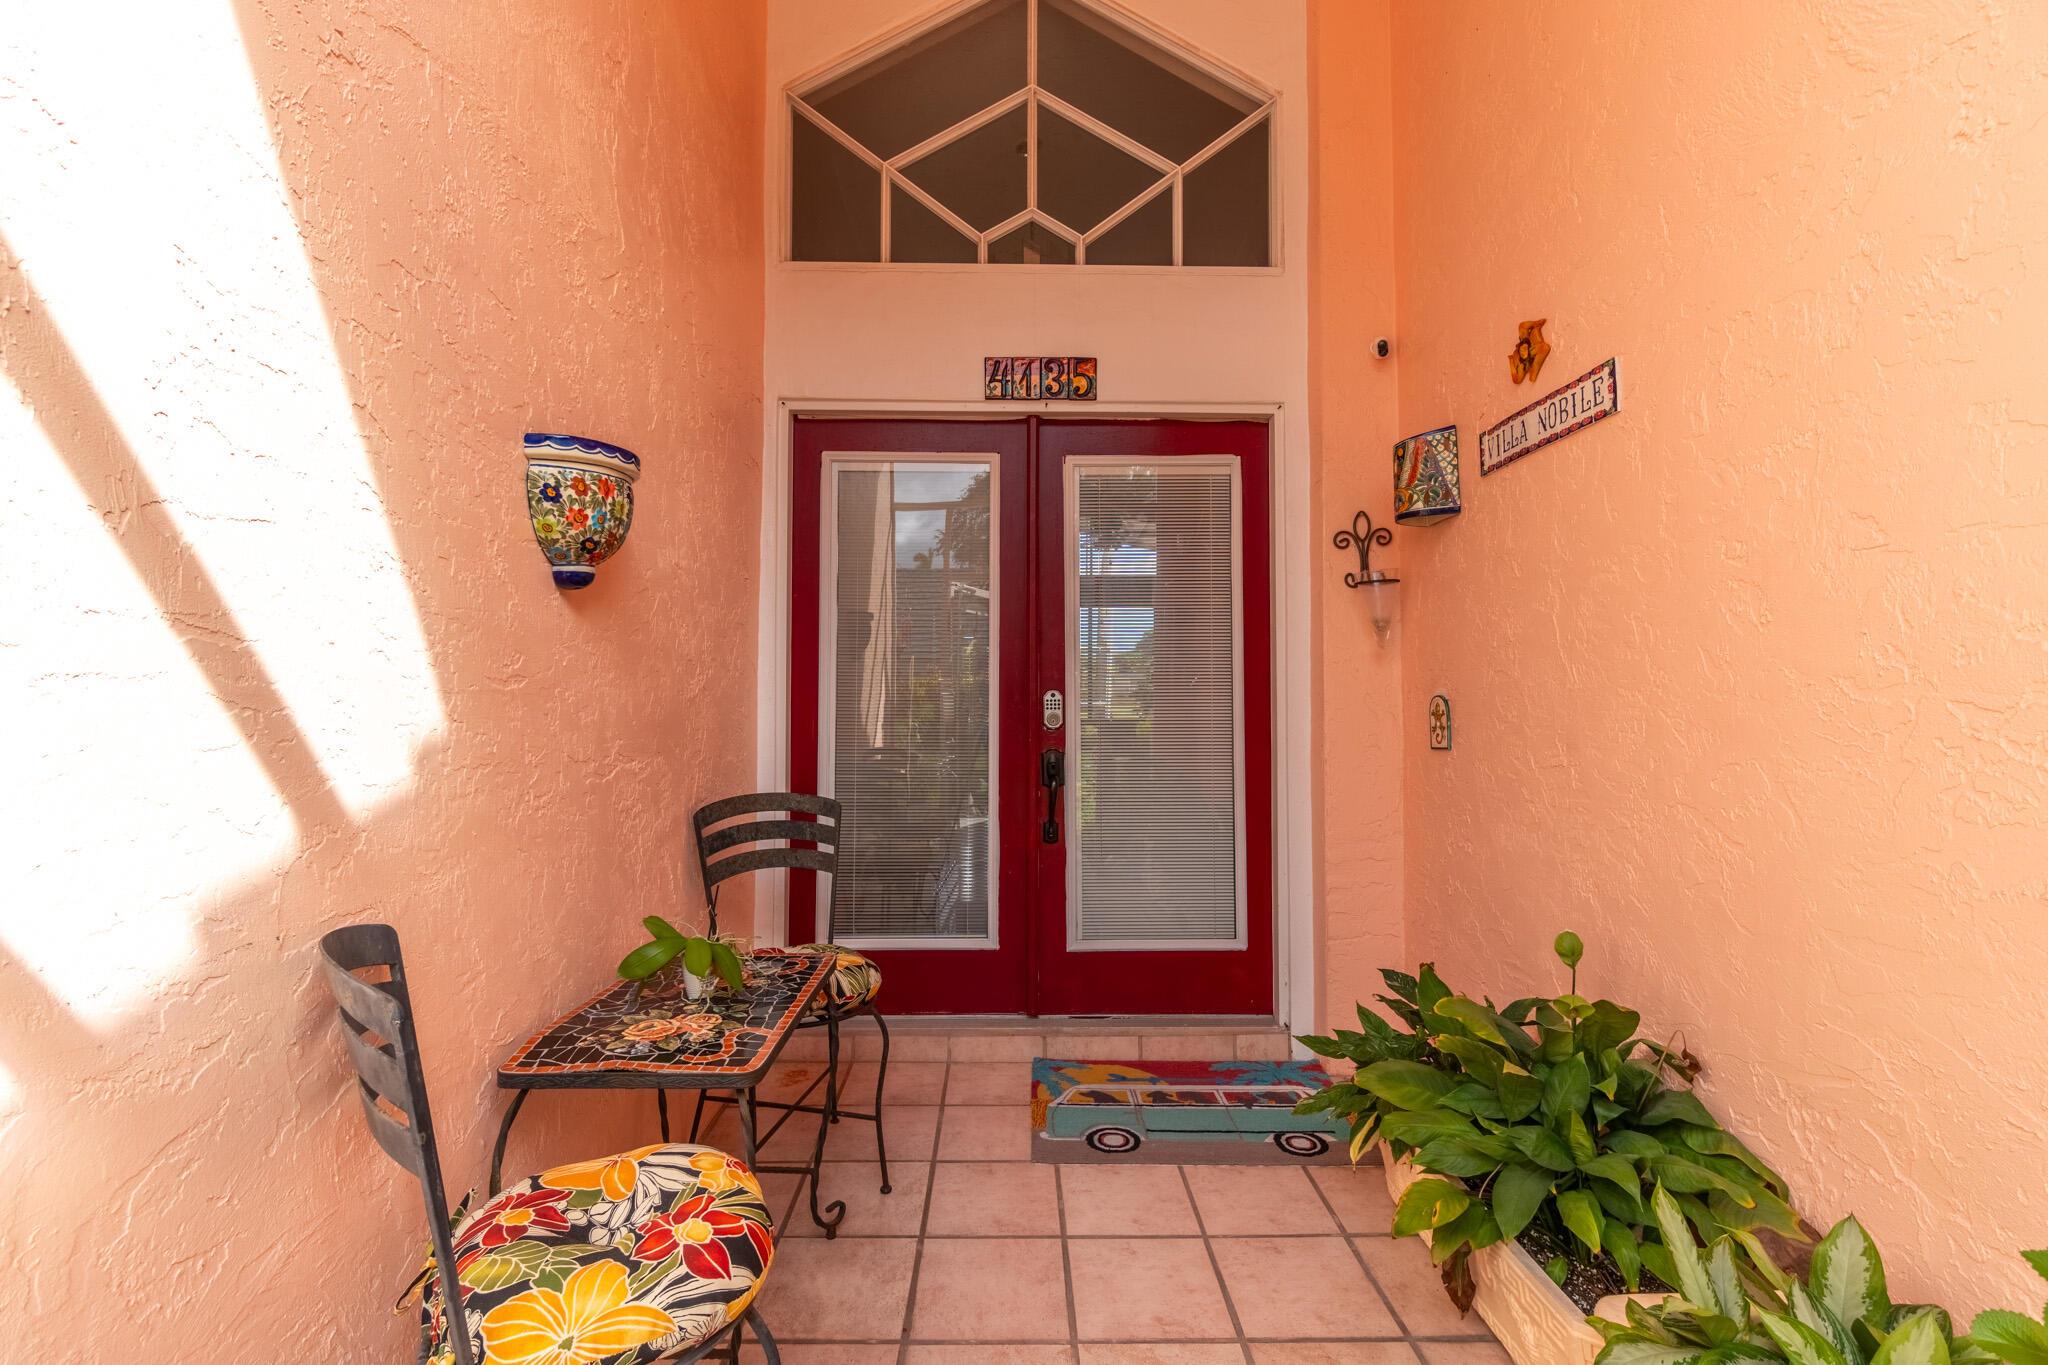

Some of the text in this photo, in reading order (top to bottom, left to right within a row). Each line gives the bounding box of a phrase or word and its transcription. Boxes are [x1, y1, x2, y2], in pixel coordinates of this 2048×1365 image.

[987, 358, 1093, 399] 4135
[1486, 375, 1605, 461] VILLA NOBILE
